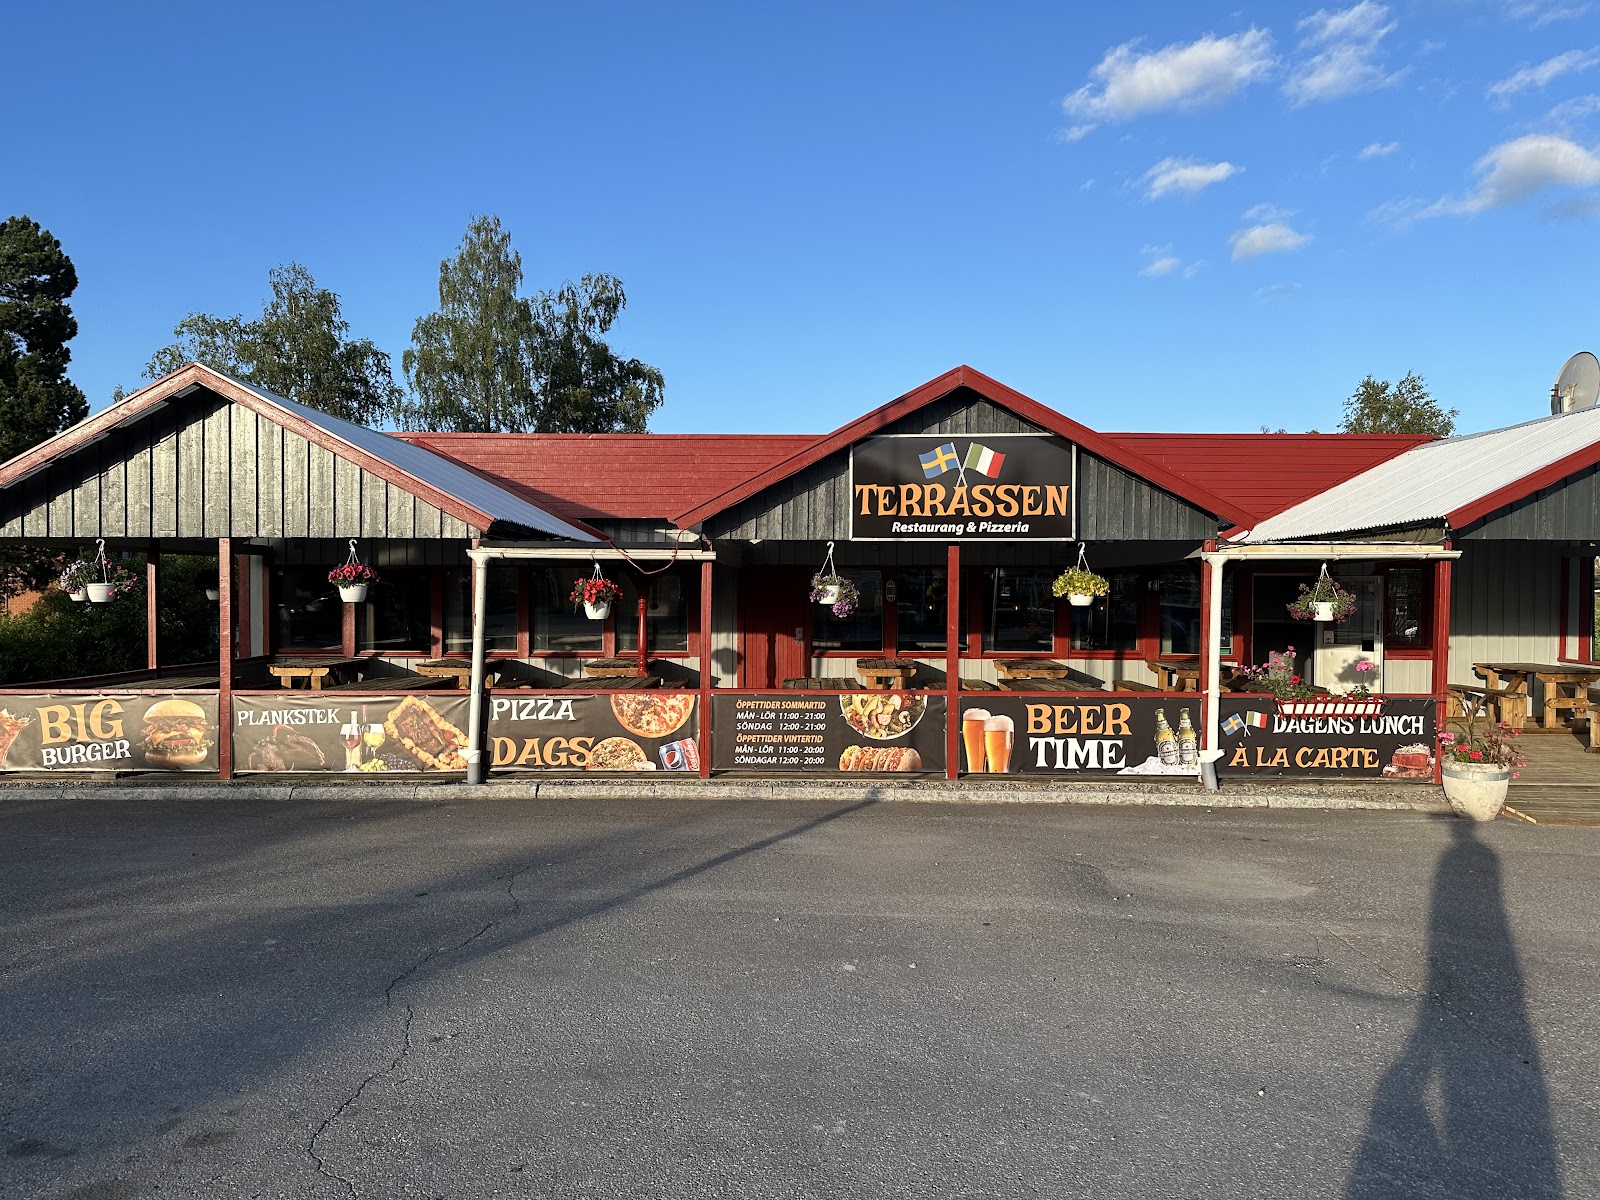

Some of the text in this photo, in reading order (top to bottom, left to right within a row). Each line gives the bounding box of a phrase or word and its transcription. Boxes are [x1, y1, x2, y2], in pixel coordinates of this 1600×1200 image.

[855, 483, 1069, 517] TERRASSEN
[892, 522, 1029, 535] Restaurang & Pizzeria
[492, 699, 576, 721] PIZZA
[736, 700, 826, 709] ÖPPETTIDER SOMMARTID
[36, 699, 125, 745] BIG
[238, 708, 340, 726] PLANKSTEK
[736, 711, 756, 720] MÅN
[761, 711, 775, 720] LÖR
[736, 722, 772, 730] SÖNDAG
[1025, 703, 1132, 735] BEER
[1273, 714, 1424, 735] DAGENS LUNCH
[736, 733, 823, 743] ÖPPETTIDER VINTERTID
[41, 739, 131, 767] BURGER
[491, 737, 596, 767] DAGS
[735, 745, 754, 754] MÅN
[759, 745, 773, 754] LÖR
[778, 746, 799, 754] 11:00
[804, 746, 824, 754] 20:00
[735, 756, 777, 764] SÖNDAGAR
[1029, 736, 1127, 769] TIME
[1229, 742, 1380, 769] À LA CARTE
